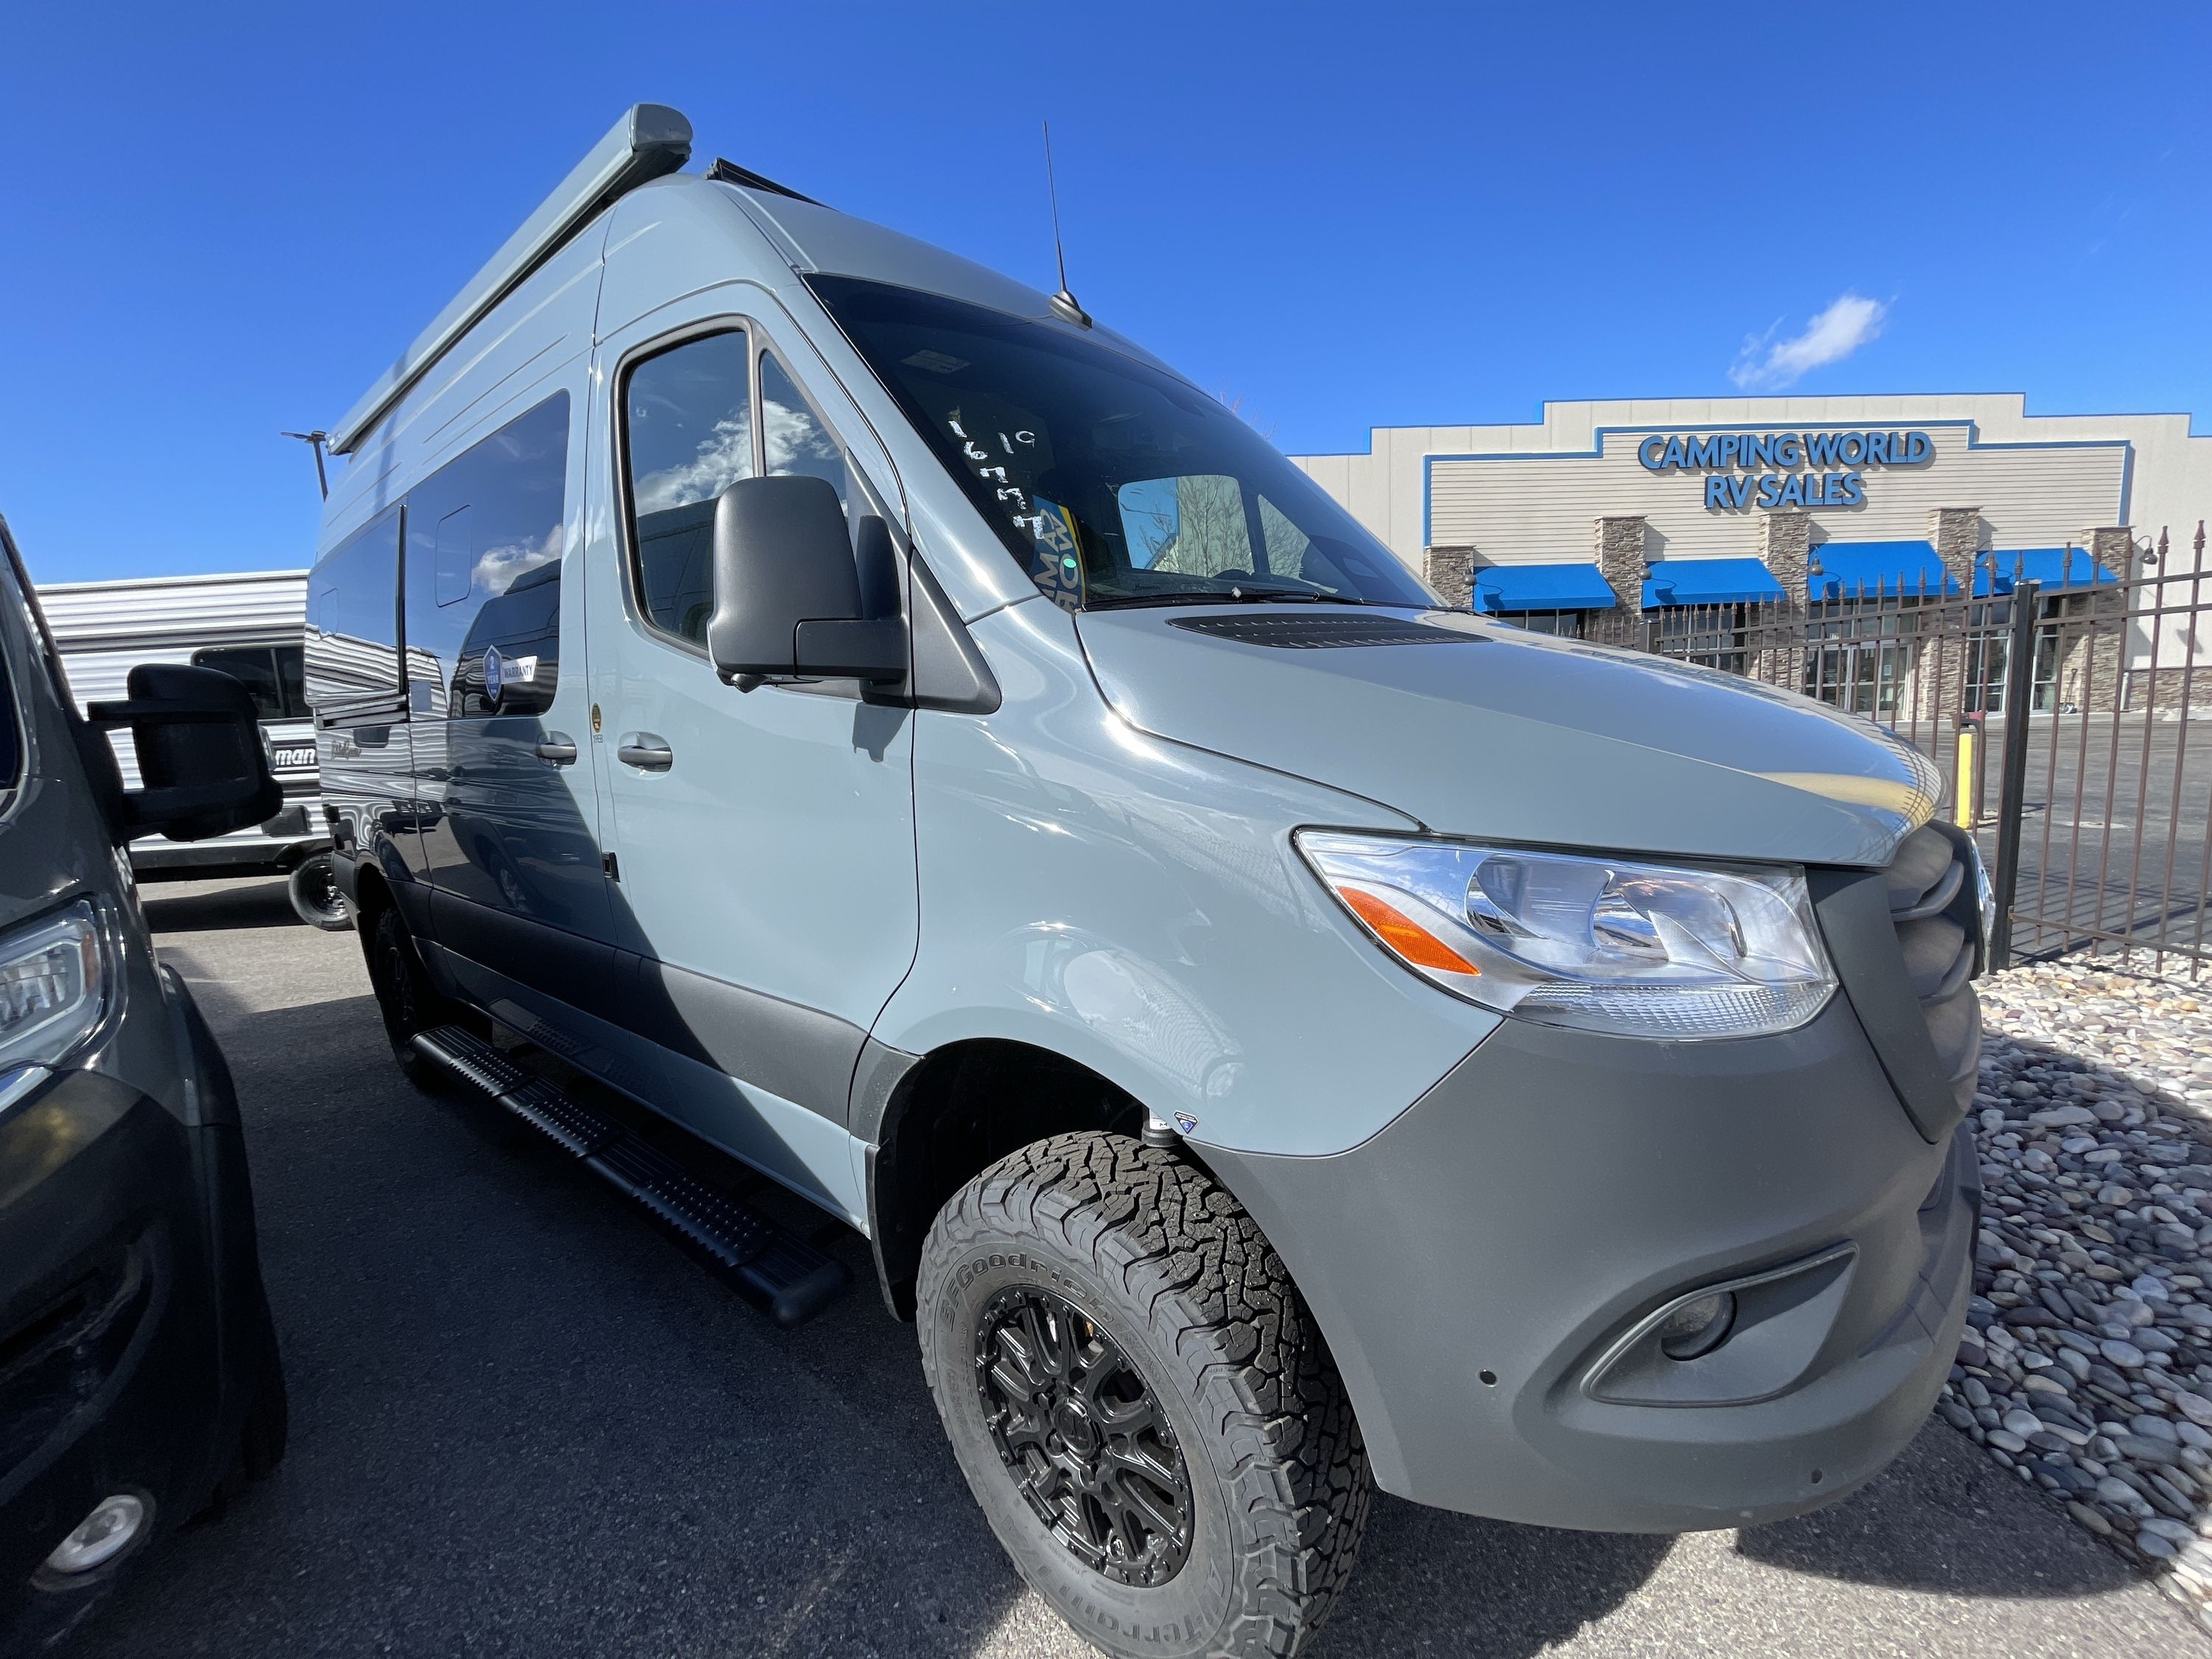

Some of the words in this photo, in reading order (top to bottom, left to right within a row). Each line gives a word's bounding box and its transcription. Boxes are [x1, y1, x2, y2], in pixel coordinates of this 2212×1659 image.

[1638, 433, 1799, 469] CAMPING
[1803, 431, 1931, 465] WORLD
[1704, 474, 1754, 509] RV
[1756, 472, 1864, 507] SALES
[490, 655, 495, 669] 2
[504, 664, 533, 678] WARRANTY
[487, 674, 499, 685] YEAR
